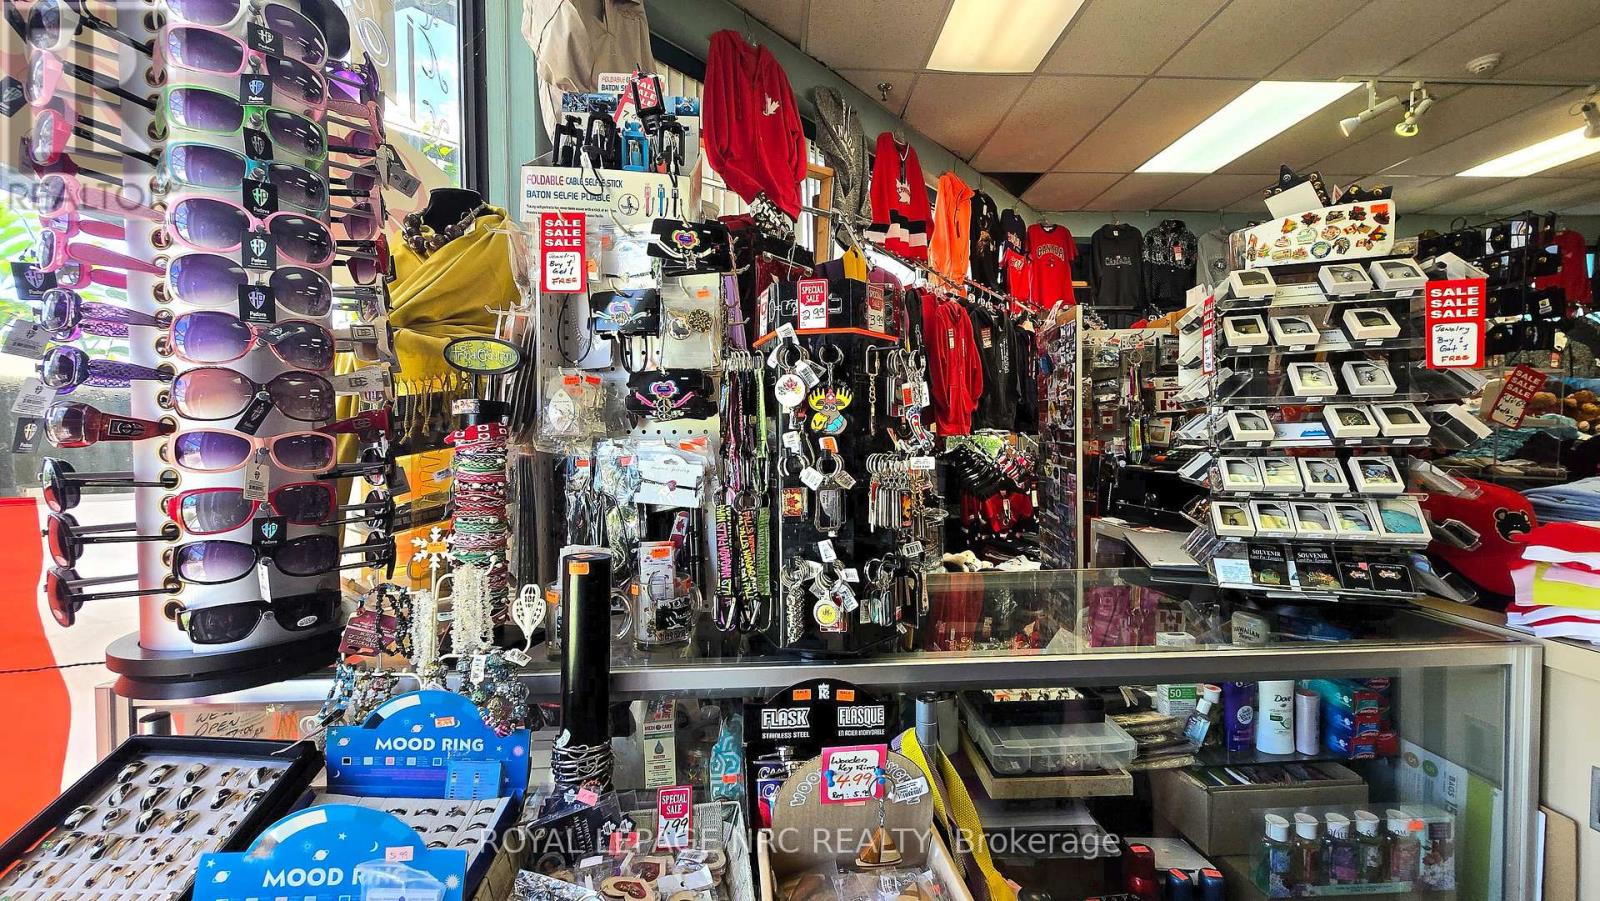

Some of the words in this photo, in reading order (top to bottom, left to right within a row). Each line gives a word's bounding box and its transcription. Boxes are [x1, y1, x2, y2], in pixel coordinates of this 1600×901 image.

[526, 174, 564, 186] FOLDABLE
[565, 176, 583, 186] CABLE
[584, 177, 606, 187] SELFIE
[606, 179, 623, 188] STICK
[526, 189, 551, 199] BATON
[553, 191, 578, 201] SELFIE
[580, 192, 611, 202] PLIABLE
[544, 219, 582, 227] SALE
[544, 238, 582, 246] SALE
[549, 260, 564, 268] Buy
[551, 277, 577, 286] FREE
[801, 286, 824, 294] SPECIAL
[1430, 286, 1480, 298] SALE
[805, 294, 820, 303] SALE
[1430, 297, 1480, 309] SALE
[1430, 308, 1480, 319] SALE
[1434, 324, 1470, 335] Jewelry
[1436, 336, 1455, 346] Buy
[1439, 344, 1458, 353] Get
[1441, 354, 1471, 363] FREE
[1515, 369, 1542, 385] SALE
[1510, 376, 1537, 392] SALE
[1506, 383, 1532, 399] SALE
[1251, 549, 1281, 557] SOUVENIR
[1169, 689, 1182, 698] 50
[761, 707, 810, 730] FLASK
[837, 705, 885, 728] FLASQUE
[195, 716, 240, 737] OPEN
[761, 732, 792, 740] STAINLESS
[375, 737, 436, 752] MOOD
[441, 737, 484, 752] RING
[830, 755, 868, 764] Wooden
[837, 764, 854, 775] Key
[836, 773, 872, 789] 4.99
[661, 794, 688, 803] SPECIAL
[666, 804, 683, 815] SALE
[661, 817, 689, 838] 1.99
[262, 867, 344, 888] MOOD
